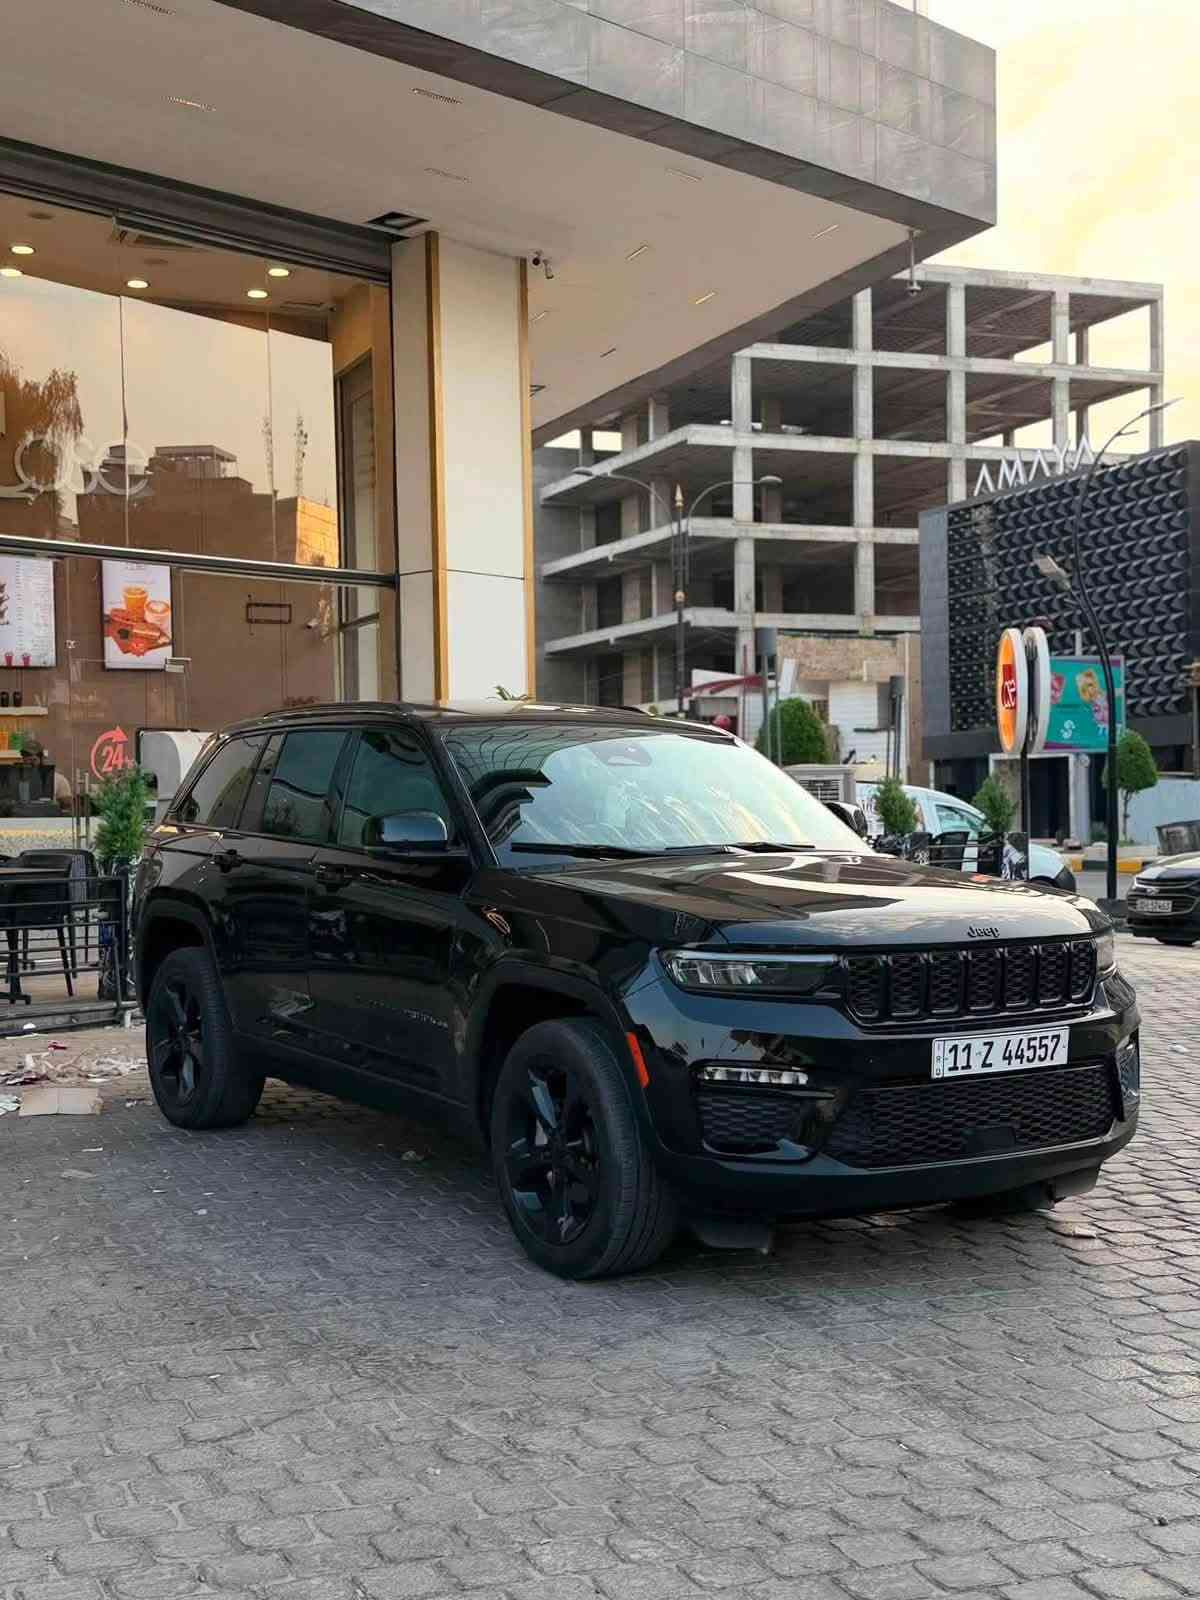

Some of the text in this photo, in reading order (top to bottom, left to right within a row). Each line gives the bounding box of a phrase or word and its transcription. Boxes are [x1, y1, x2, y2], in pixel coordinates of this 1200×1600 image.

[967, 925, 1000, 938] Jeep
[948, 1034, 1061, 1071] 11 Z 44557
